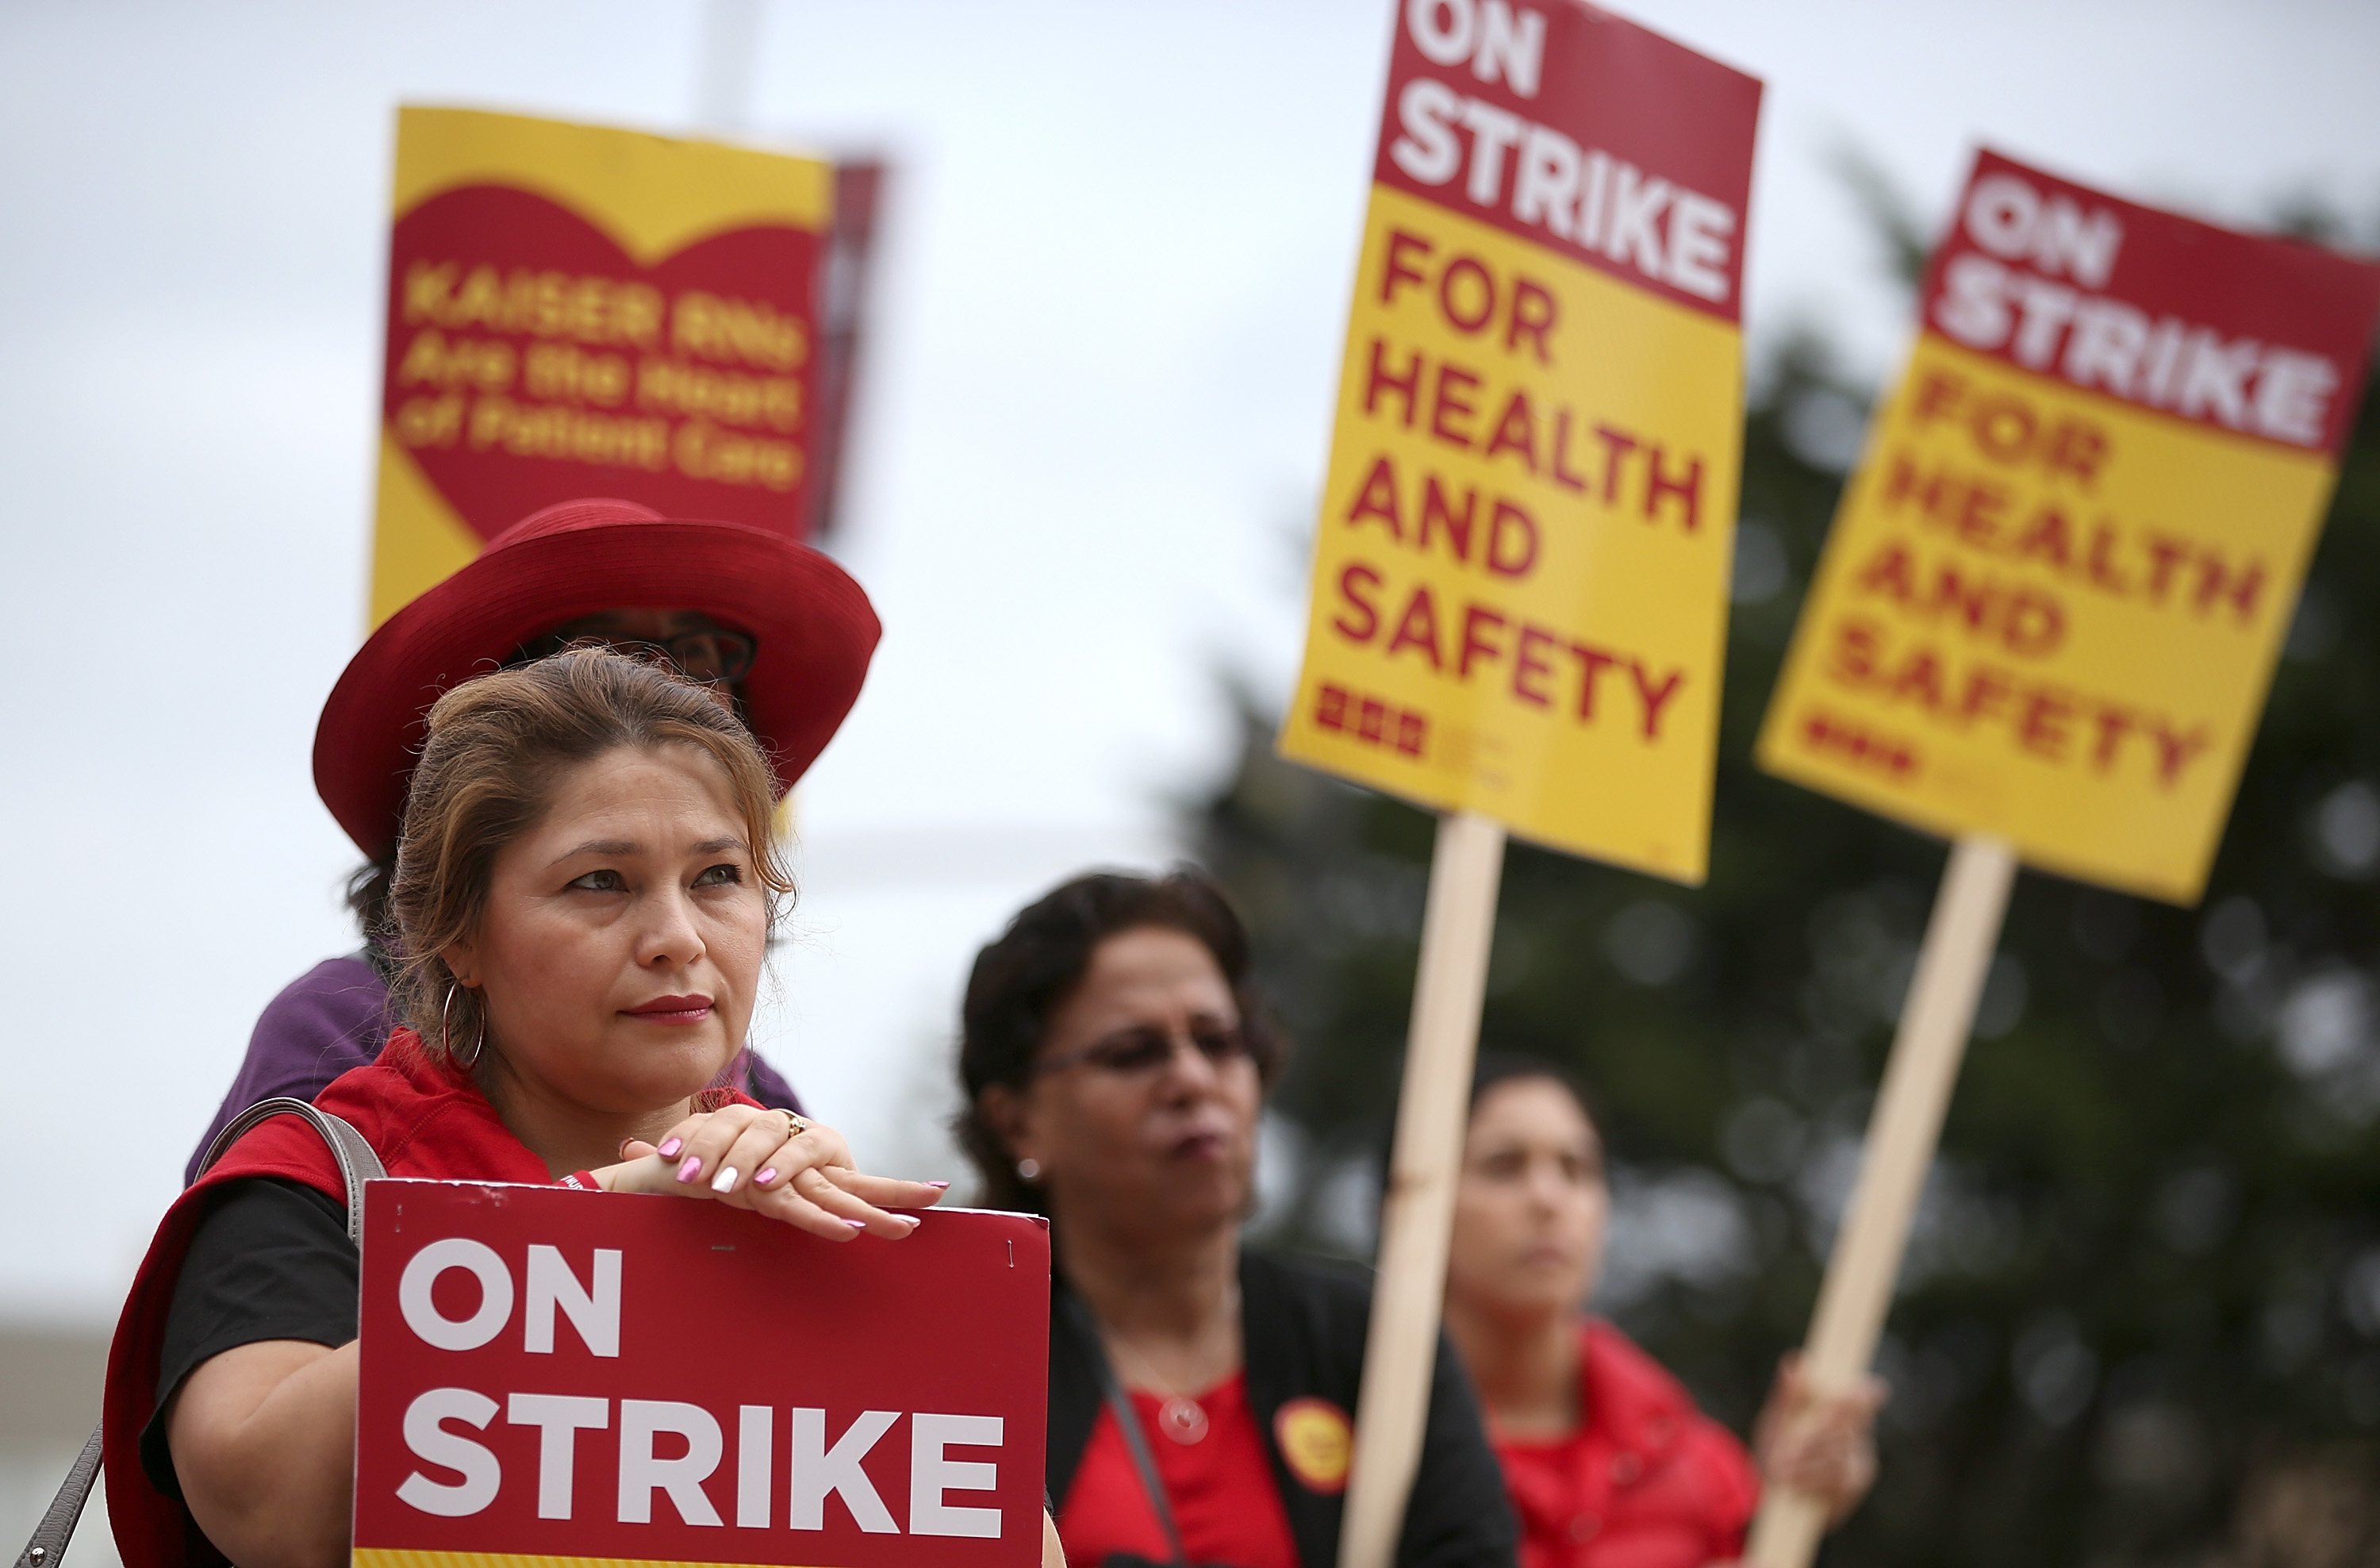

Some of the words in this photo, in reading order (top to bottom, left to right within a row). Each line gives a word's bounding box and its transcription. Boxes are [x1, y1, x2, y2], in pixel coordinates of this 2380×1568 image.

[1406, 0, 1548, 98] ON
[1390, 77, 1736, 303] STRIKE
[1967, 176, 2120, 286] ON
[405, 263, 662, 346] KAISER
[1379, 227, 1560, 367] FOR
[1936, 256, 2334, 444] STRIKE
[397, 390, 464, 450] of
[471, 396, 666, 470] Patient
[673, 417, 806, 494] Care
[399, 327, 516, 394] Are
[524, 341, 630, 406] the
[635, 354, 802, 433] Heart
[1361, 337, 1704, 535] HEALTH
[1915, 369, 2107, 489] FOR
[1345, 456, 1541, 581] AND
[1884, 455, 2263, 625] HEALTH
[1331, 562, 1685, 744] SAFETY
[1860, 546, 2064, 654] AND
[1828, 622, 2208, 786] SAFETY
[398, 1238, 623, 1359] ON
[395, 1387, 1004, 1539] STRIKE
